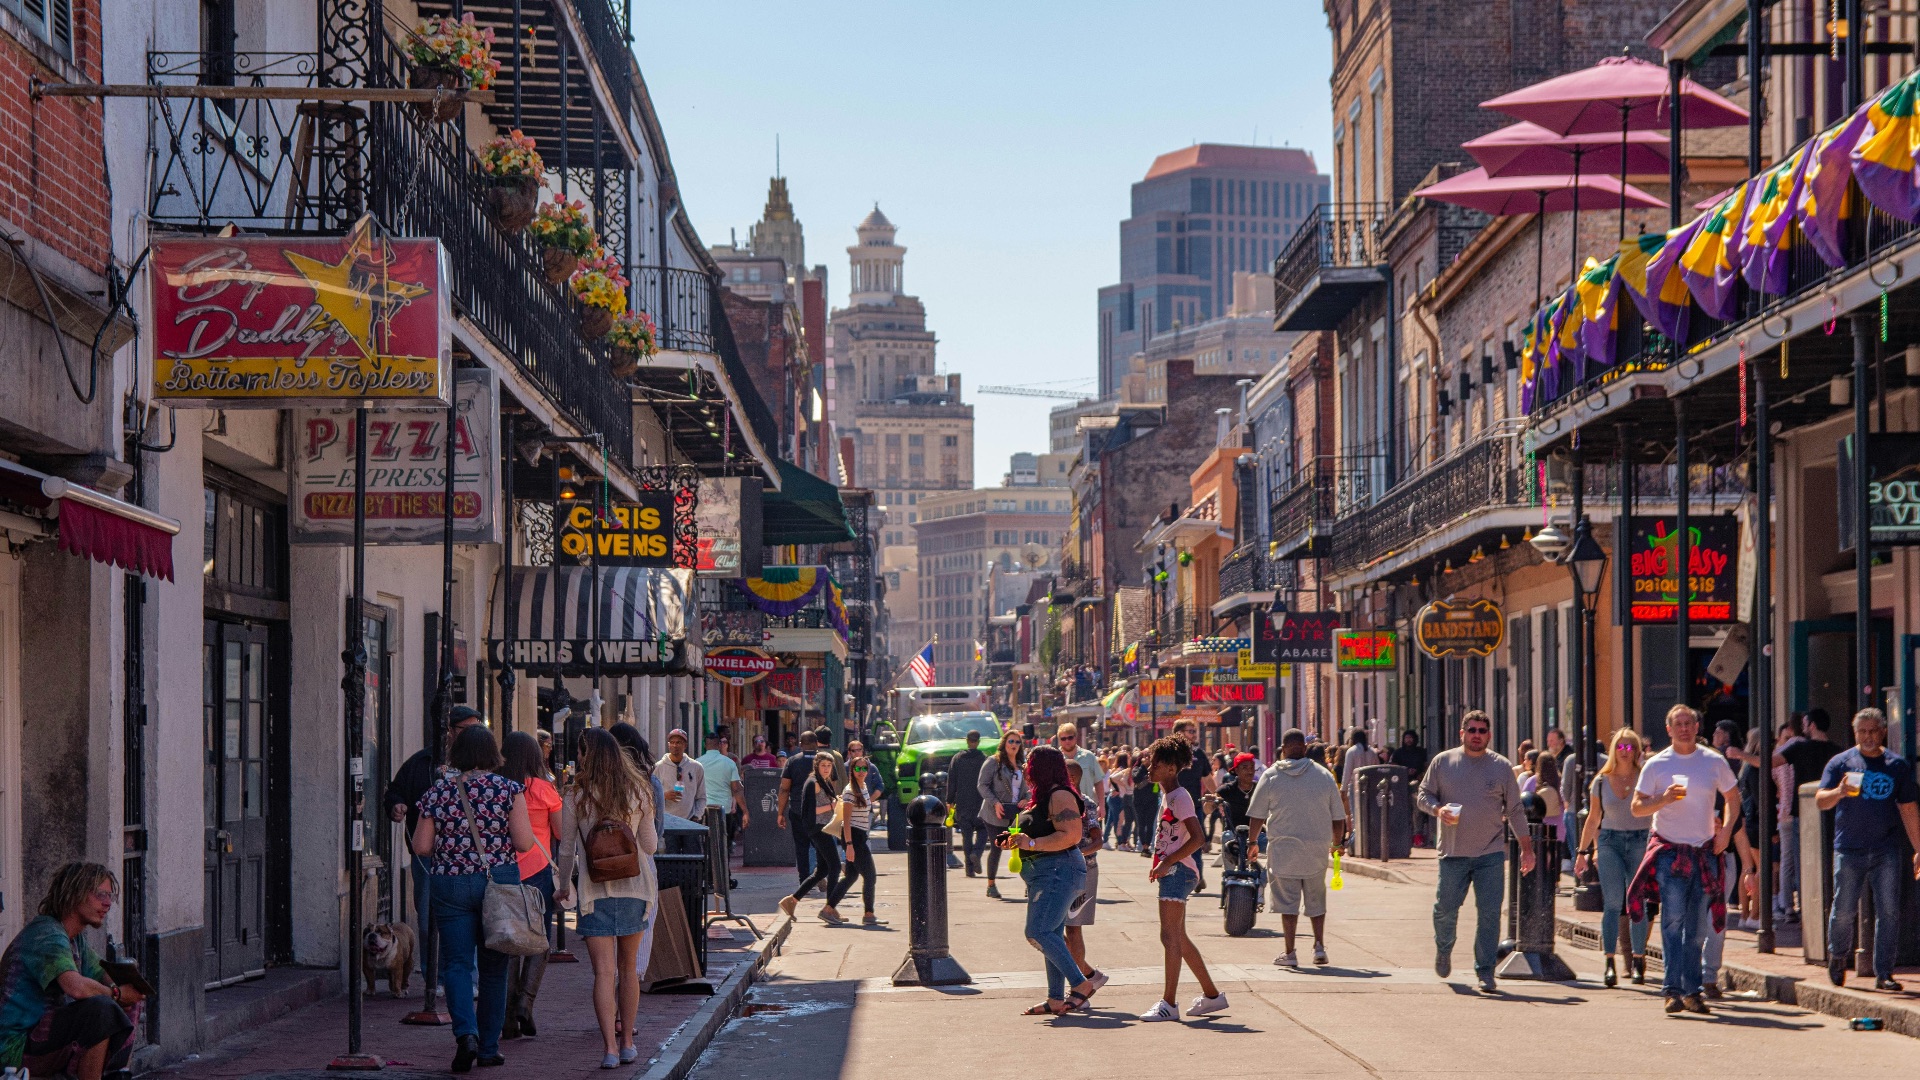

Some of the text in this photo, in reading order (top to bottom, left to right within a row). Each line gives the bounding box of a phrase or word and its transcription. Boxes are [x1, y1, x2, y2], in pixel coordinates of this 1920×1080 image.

[177, 248, 275, 310] Big
[162, 303, 350, 368] Daddy's
[164, 362, 434, 395] Bottomless Topless
[306, 415, 480, 463] PIZZA
[311, 495, 476, 515] PIZZA BY THE SLCE
[561, 533, 667, 557] OWENS
[1631, 545, 1669, 576] BIG
[1631, 605, 1658, 619] IZZA
[1262, 629, 1332, 641] SUTR
[1423, 621, 1499, 639] BANDSTAND
[496, 641, 573, 663] CHRIS
[583, 640, 675, 664] OWENS
[704, 658, 775, 670] DIXIELAND
[1221, 684, 1244, 701] LEGAL
[1245, 683, 1265, 700] CLUB
